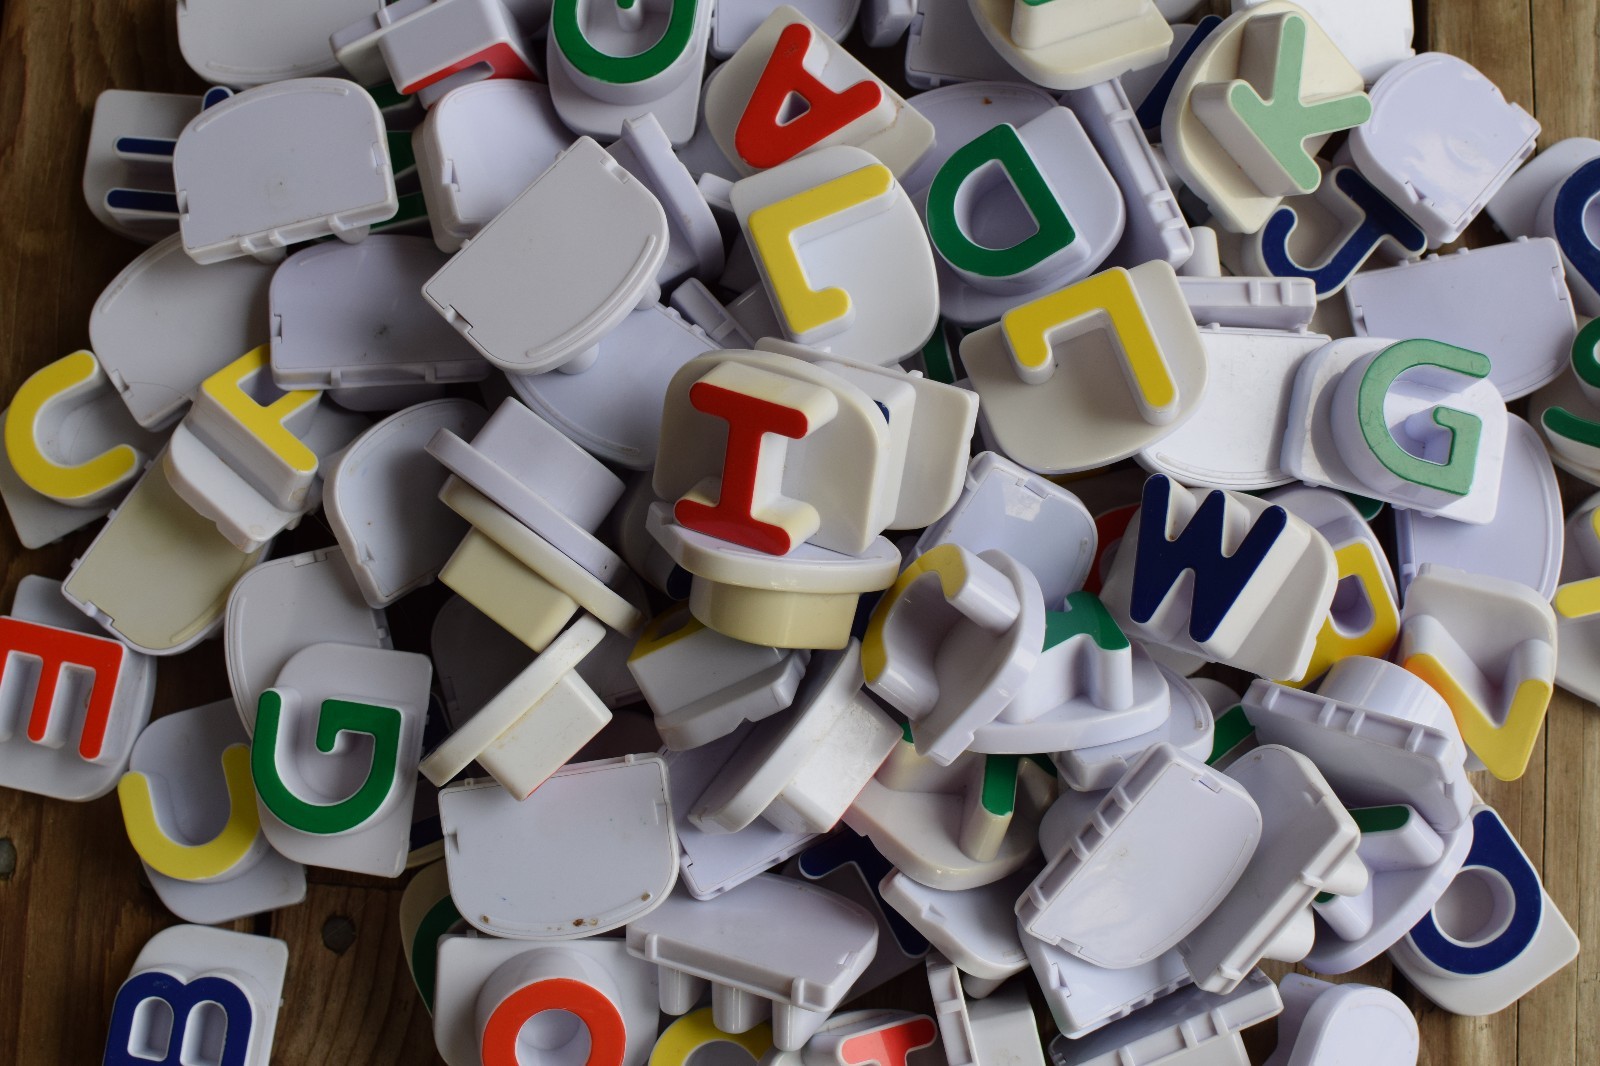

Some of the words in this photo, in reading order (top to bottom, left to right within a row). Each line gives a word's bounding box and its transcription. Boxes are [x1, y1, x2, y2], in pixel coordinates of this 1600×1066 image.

[734, 23, 883, 169] A
[1230, 15, 1372, 194] K
[926, 123, 1076, 278] D
[1262, 166, 1427, 296] J
[5, 350, 138, 499] C
[674, 381, 809, 562] I
[1358, 338, 1491, 496] G
[1129, 474, 1287, 643] W
[0, 615, 124, 760] E
[1404, 653, 1552, 781] V
[251, 690, 402, 834] G
[102, 971, 253, 1066] B
